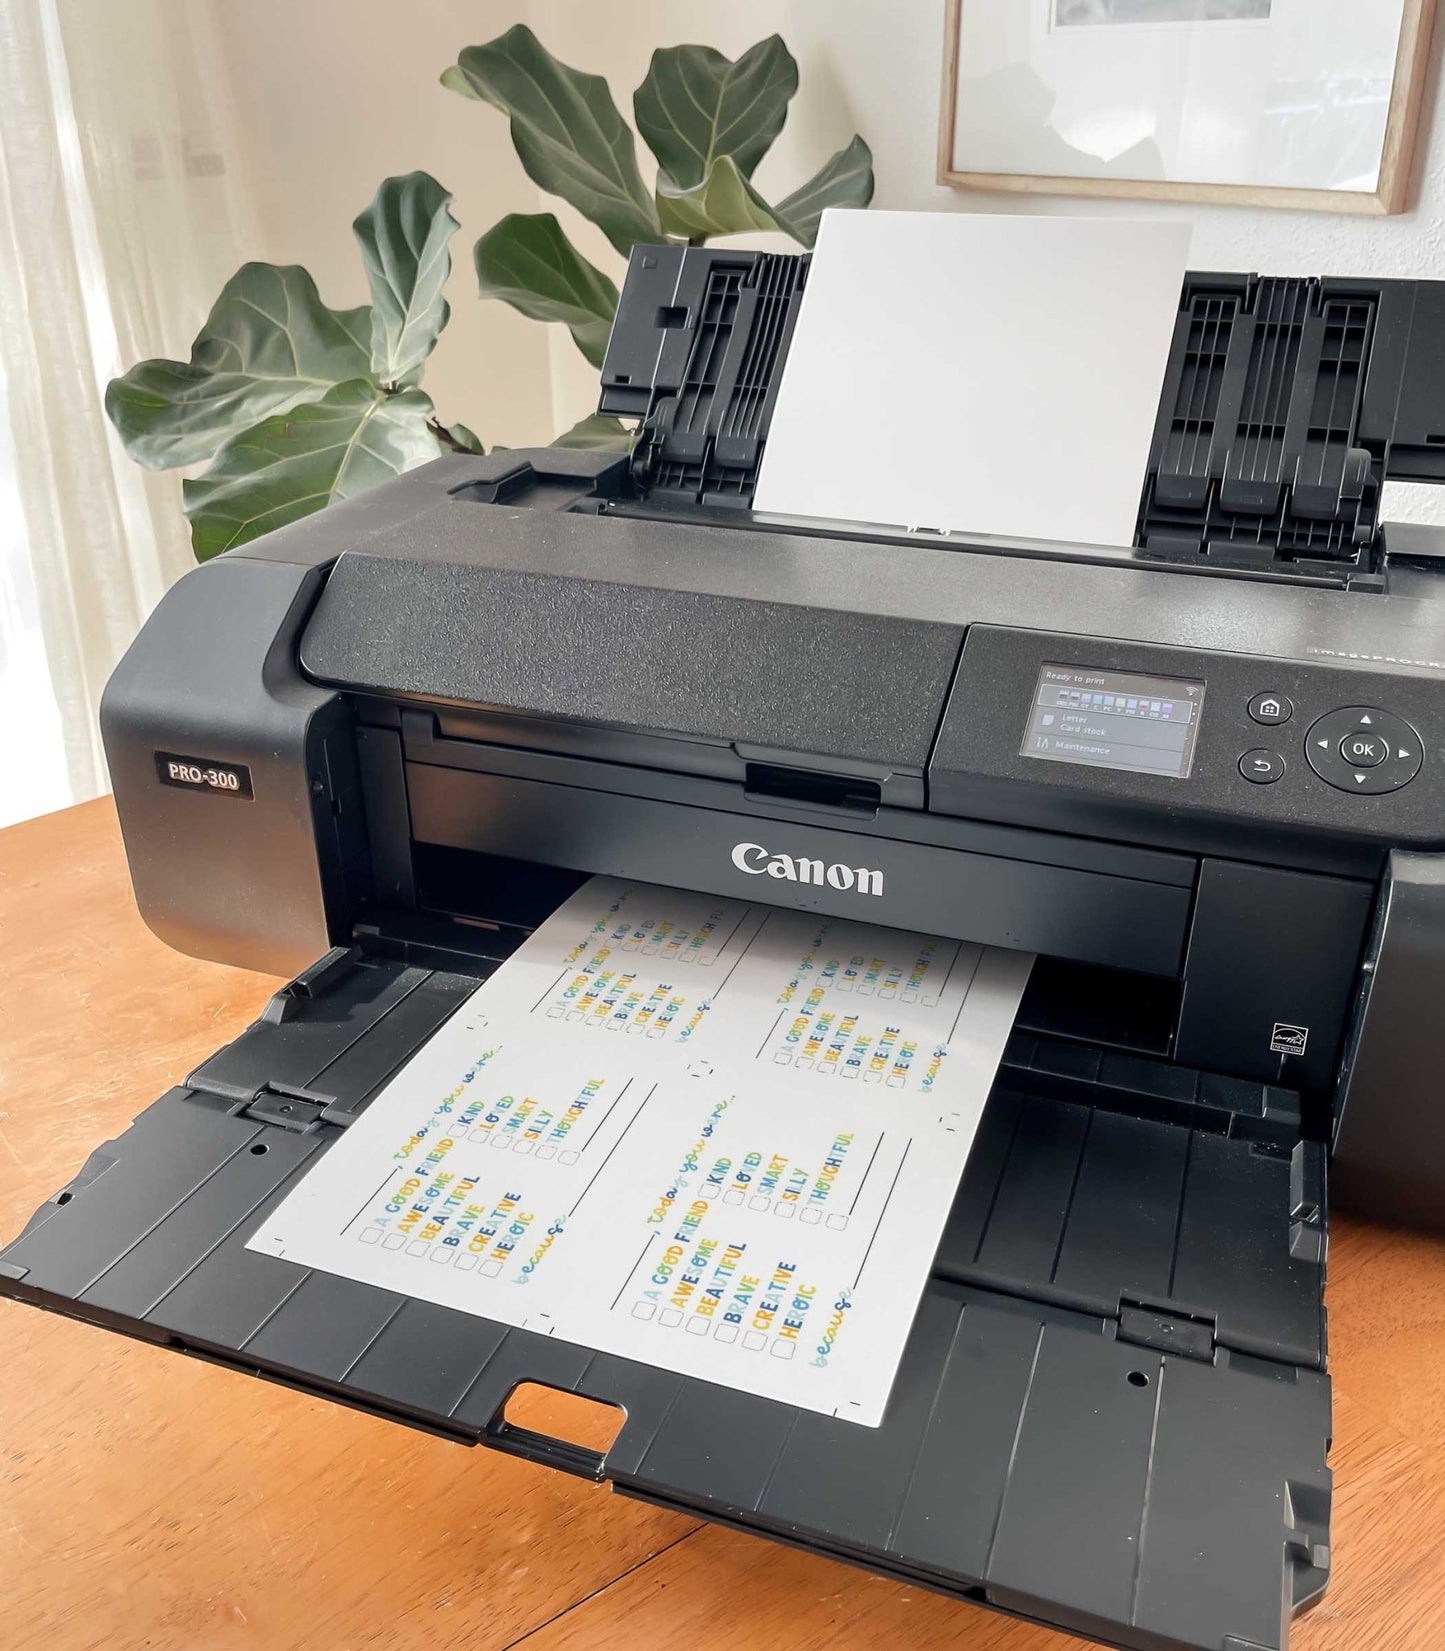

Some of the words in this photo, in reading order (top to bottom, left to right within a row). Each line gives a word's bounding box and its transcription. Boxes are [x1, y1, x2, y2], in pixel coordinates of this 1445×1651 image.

[1046, 671, 1072, 682] Ready
[1085, 677, 1105, 686] print
[1060, 723, 1081, 733] Card
[1083, 727, 1106, 736] stock
[1062, 713, 1088, 724] Letter
[1055, 741, 1110, 755] Maintenance
[1353, 743, 1375, 757] OK
[167, 762, 239, 789] PRO-300
[731, 842, 884, 897] Canon
[555, 1000, 568, 1008] A
[562, 975, 589, 999] GOOD
[582, 948, 611, 974] FRIEND
[575, 970, 616, 1012] AWESOME
[594, 972, 638, 1016] BEAUTIFUL
[614, 990, 644, 1020] BRAVE
[634, 983, 673, 1024] CREATIVE
[653, 996, 686, 1029] HEROIC
[675, 998, 712, 1044] because
[800, 987, 825, 1016] FRIEND
[780, 1044, 794, 1053] A
[785, 1017, 809, 1043] GOOD
[801, 1012, 836, 1058] AWESOME
[823, 1014, 859, 1062] BEAUTIFUL
[846, 1035, 873, 1067] BRAVE
[869, 1026, 901, 1071] CREATIVE
[891, 1040, 919, 1076] HEROIC
[917, 1042, 947, 1094] because
[392, 1117, 440, 1161] today
[433, 1084, 465, 1115] you
[457, 1099, 485, 1126] KIND
[479, 1095, 516, 1131] LOVED
[501, 1097, 539, 1135] SMART
[523, 1109, 555, 1140] SILLY
[546, 1078, 606, 1144] THOUGHTFUL
[375, 1214, 391, 1227] A
[385, 1177, 421, 1214] GOOD
[414, 1137, 455, 1177] FRIEND
[647, 1171, 689, 1224] today
[679, 1138, 706, 1174] you
[706, 1156, 732, 1185] KIND
[731, 1151, 763, 1190] LOVED
[756, 1153, 789, 1196] SMART
[782, 1167, 810, 1202] SILLY
[807, 1131, 855, 1207] THOUGHTFUL
[396, 1171, 455, 1235] AWESOME
[418, 1174, 481, 1241] BEAUTIFUL
[467, 1191, 522, 1253] CREATIVE
[674, 1200, 709, 1243] FRIEND
[442, 1203, 485, 1247] BRAVE
[490, 1211, 536, 1261] HEROIC
[512, 1213, 567, 1286] because
[651, 1244, 685, 1285] GOOD
[643, 1289, 662, 1301] A
[669, 1238, 719, 1309] AWESOME
[695, 1242, 747, 1317] BEAUTIFUL
[722, 1273, 760, 1325] BRAVE
[751, 1261, 797, 1331] CREATIVE
[778, 1283, 817, 1339] HEROIC
[808, 1286, 852, 1369] because
